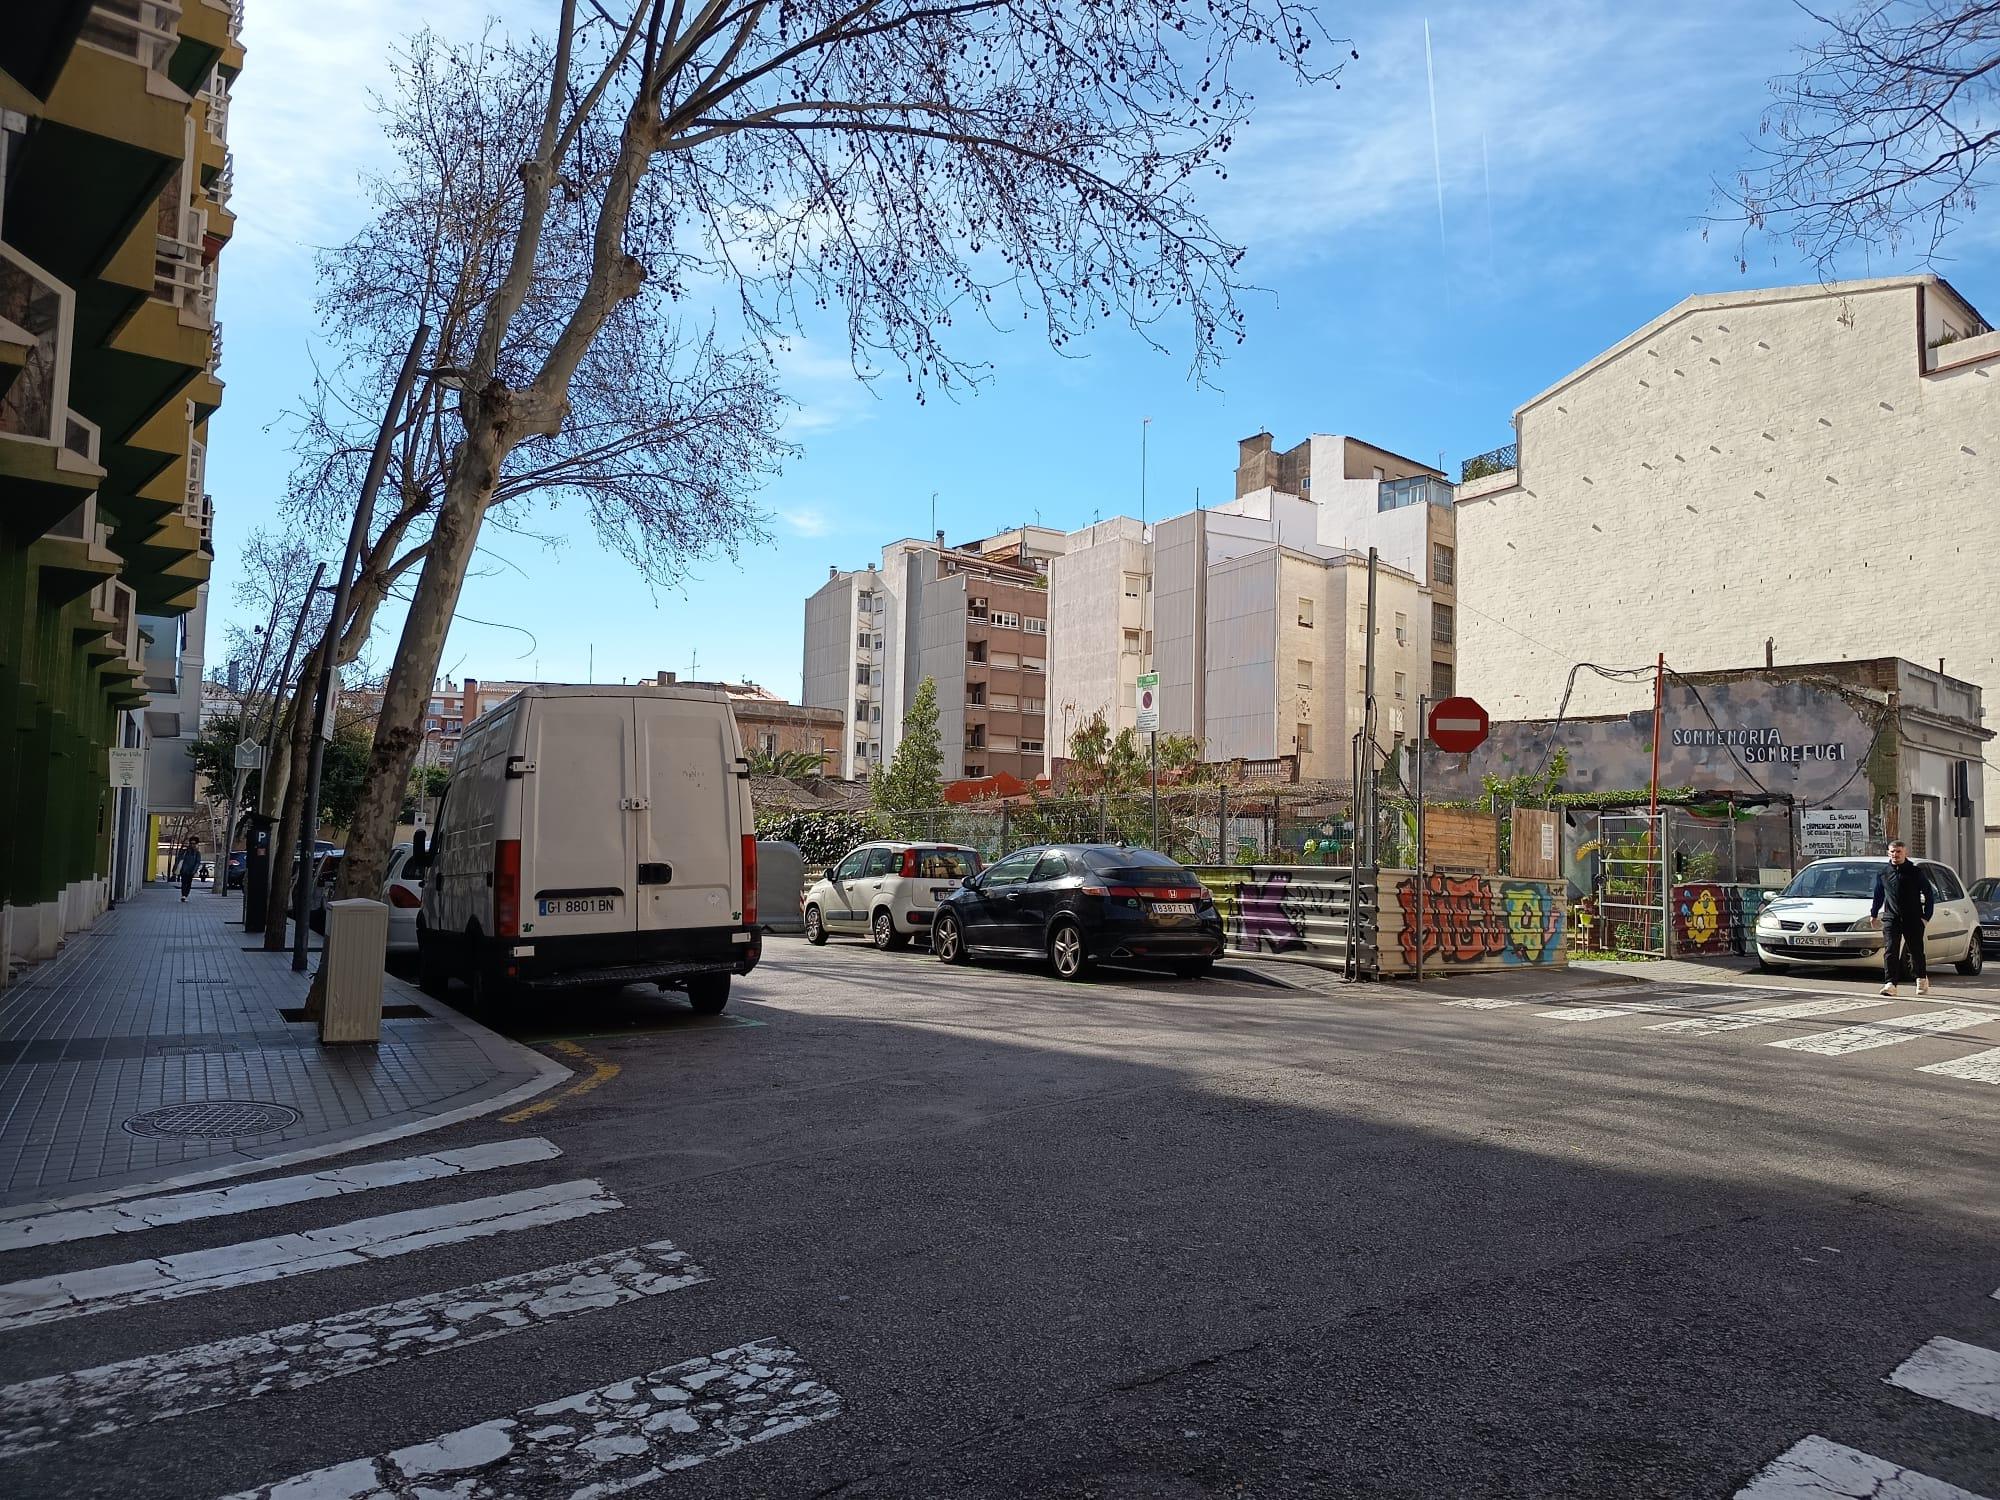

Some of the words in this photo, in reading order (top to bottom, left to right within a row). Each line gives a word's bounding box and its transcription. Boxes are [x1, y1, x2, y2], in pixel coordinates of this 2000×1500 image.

[258, 831, 266, 842] P
[566, 900, 595, 912] 8801
[598, 900, 614, 911] BN
[1157, 904, 1176, 912] 8387
[1795, 937, 1814, 945] 0245
